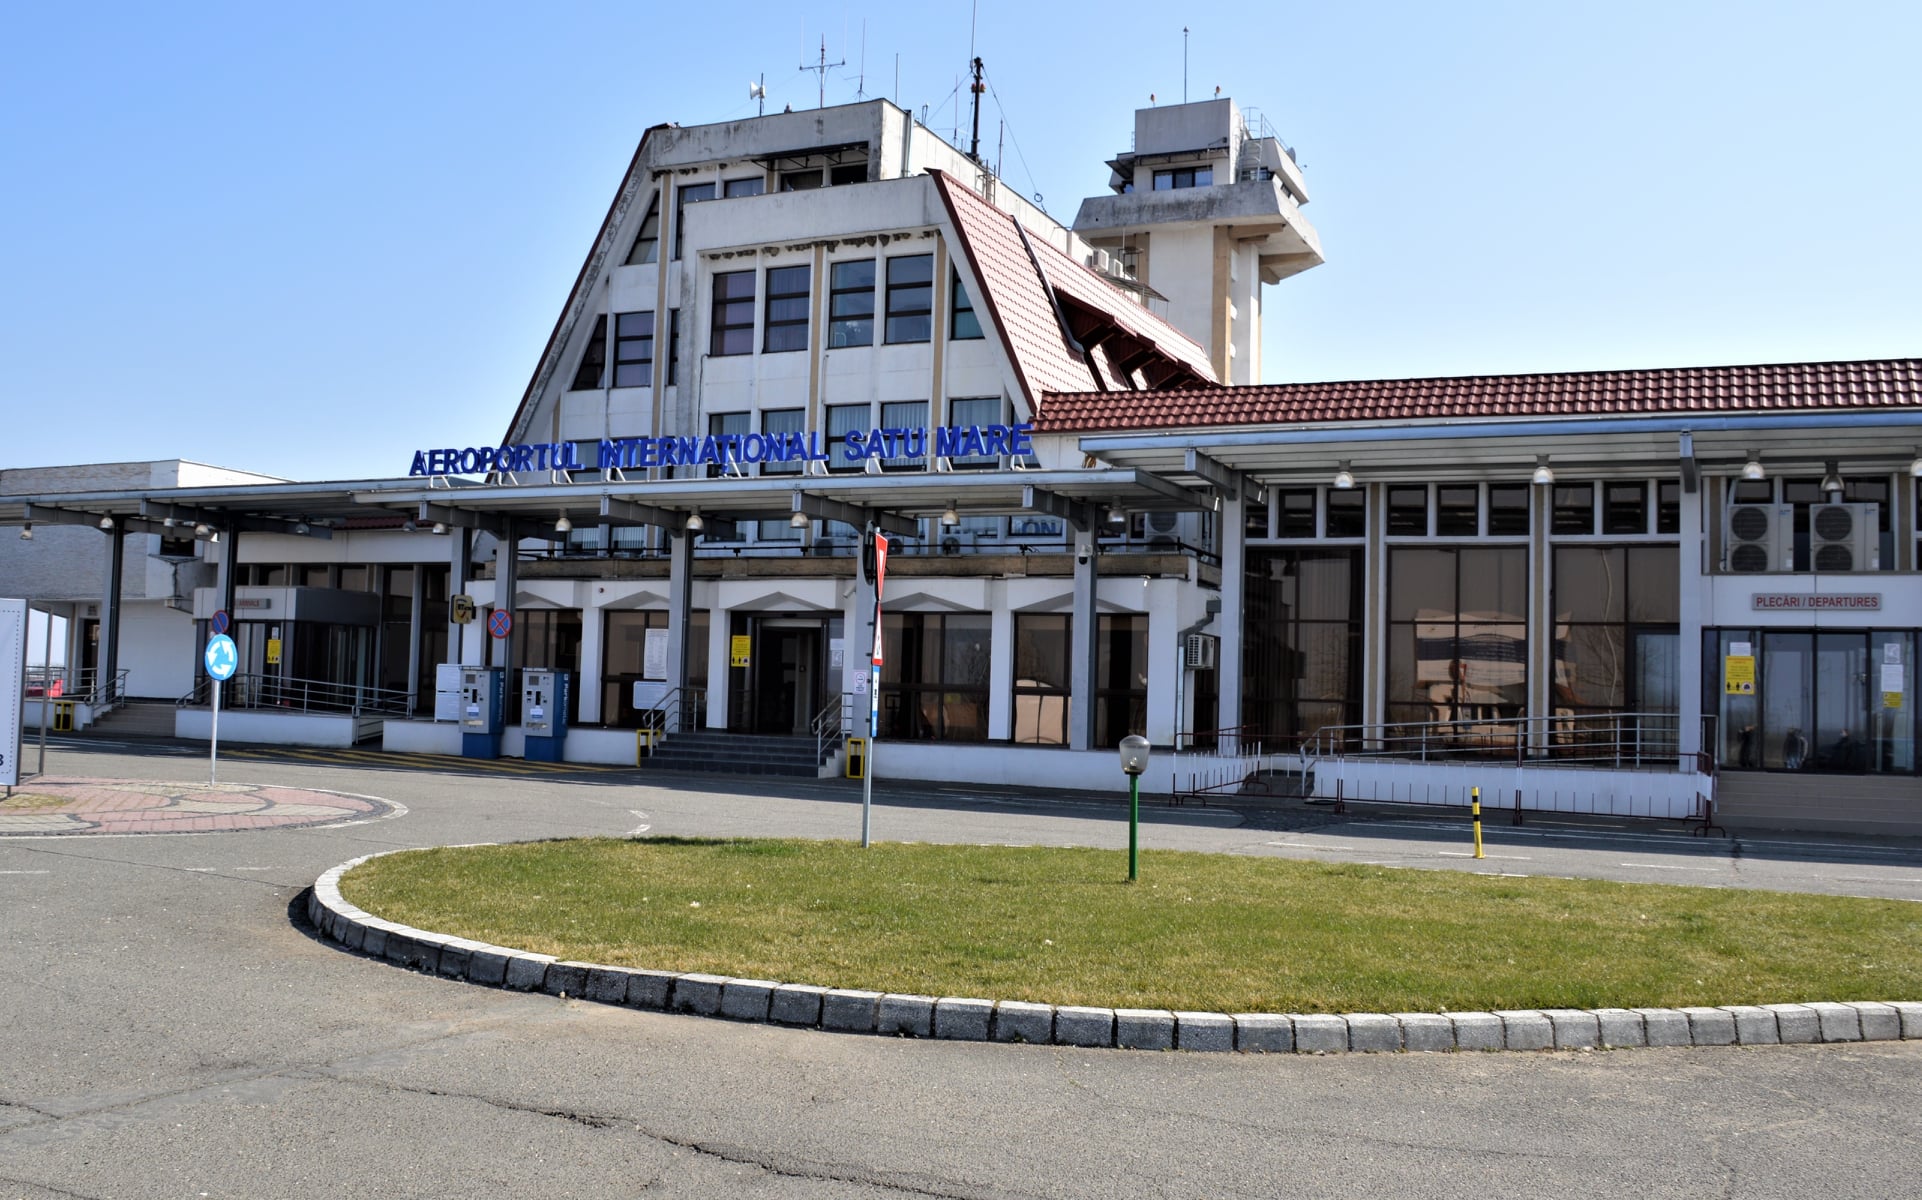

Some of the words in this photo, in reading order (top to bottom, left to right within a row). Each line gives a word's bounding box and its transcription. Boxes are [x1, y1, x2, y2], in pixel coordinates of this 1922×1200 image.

[409, 442, 585, 476] AEROPORTUL
[597, 431, 830, 473] INTERNAȚIONAL
[844, 427, 926, 461] SATU
[936, 423, 1034, 457] MARE
[1808, 597, 1878, 607] DEPARTURES
